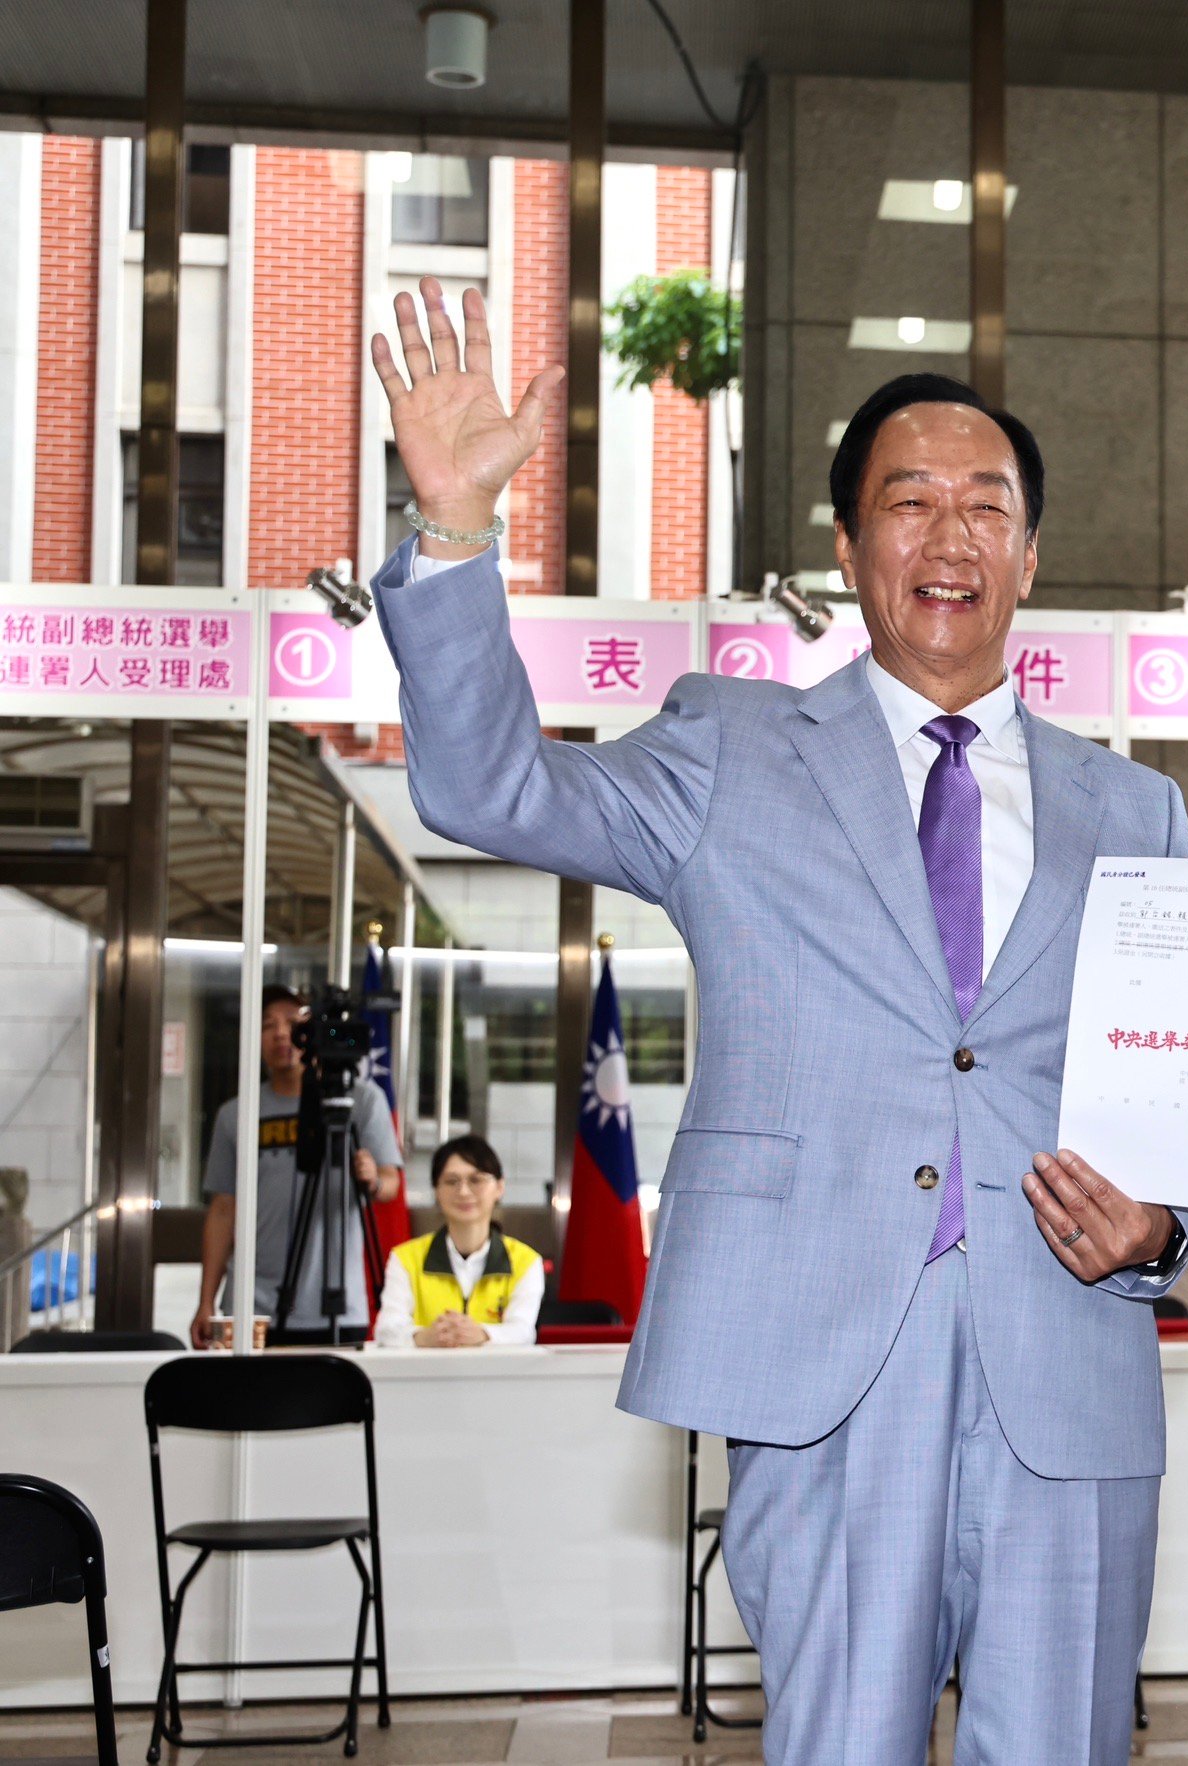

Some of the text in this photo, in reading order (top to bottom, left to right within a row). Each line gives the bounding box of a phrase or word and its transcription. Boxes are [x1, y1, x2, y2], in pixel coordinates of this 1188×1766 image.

[2, 615, 230, 648] 統副總統選舉
[586, 637, 641, 690] 表
[1013, 649, 1064, 700] 件
